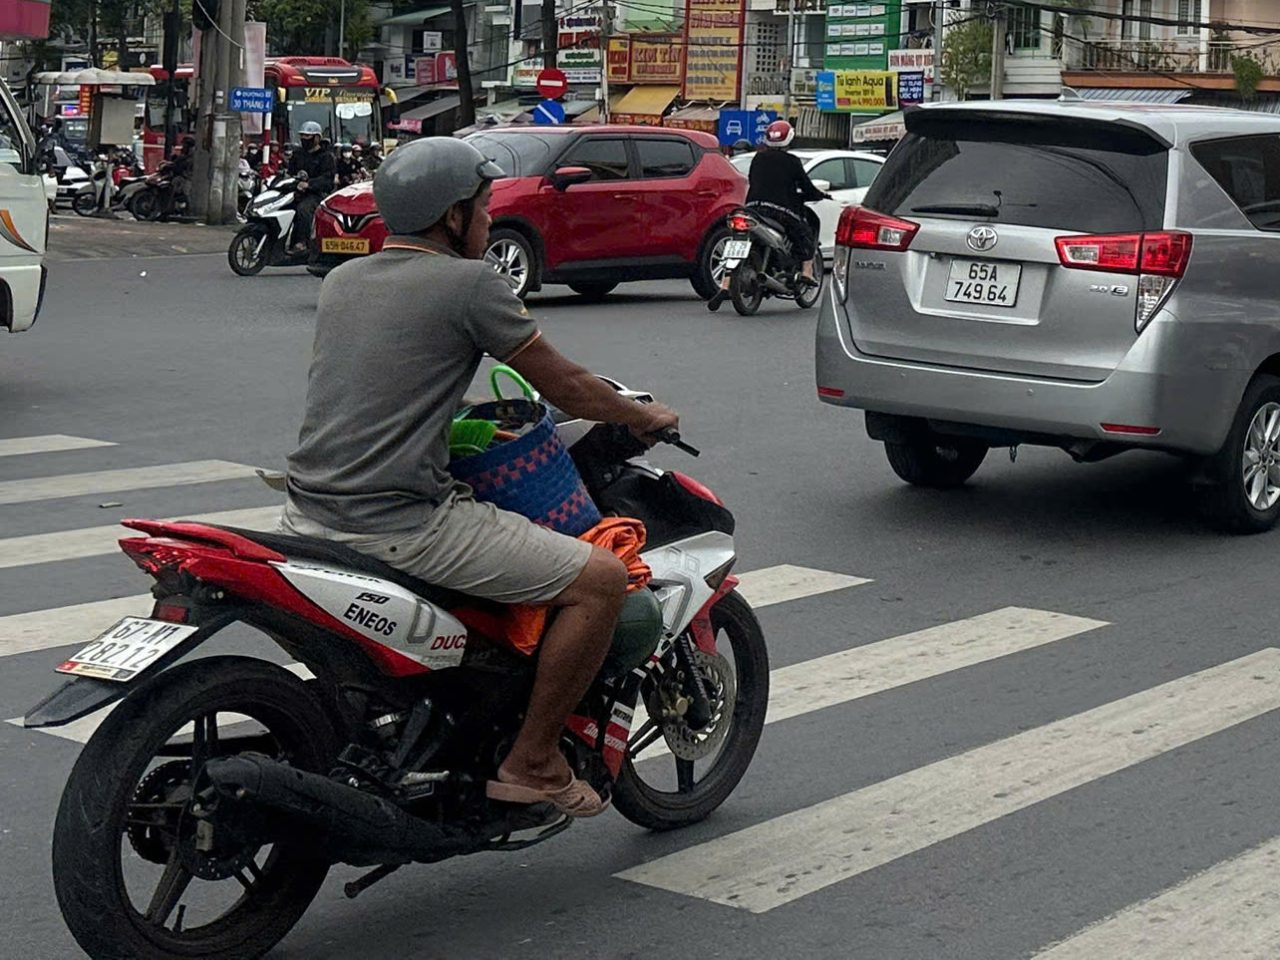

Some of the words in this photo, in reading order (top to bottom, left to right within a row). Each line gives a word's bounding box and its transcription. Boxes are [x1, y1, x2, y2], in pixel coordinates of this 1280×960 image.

[634, 47, 658, 63] KIM
[660, 44, 681, 63] TÍN
[845, 75, 861, 88] lạnh
[863, 76, 884, 89] Aqua
[304, 88, 330, 97] VIP
[234, 100, 241, 108] 30
[242, 97, 265, 109] THÁNG
[265, 100, 270, 109] 4
[968, 262, 998, 282] 65A
[954, 281, 1007, 303] 749.64
[355, 592, 390, 605] 150
[343, 603, 398, 636] ENEOS
[431, 634, 467, 651] DUC
